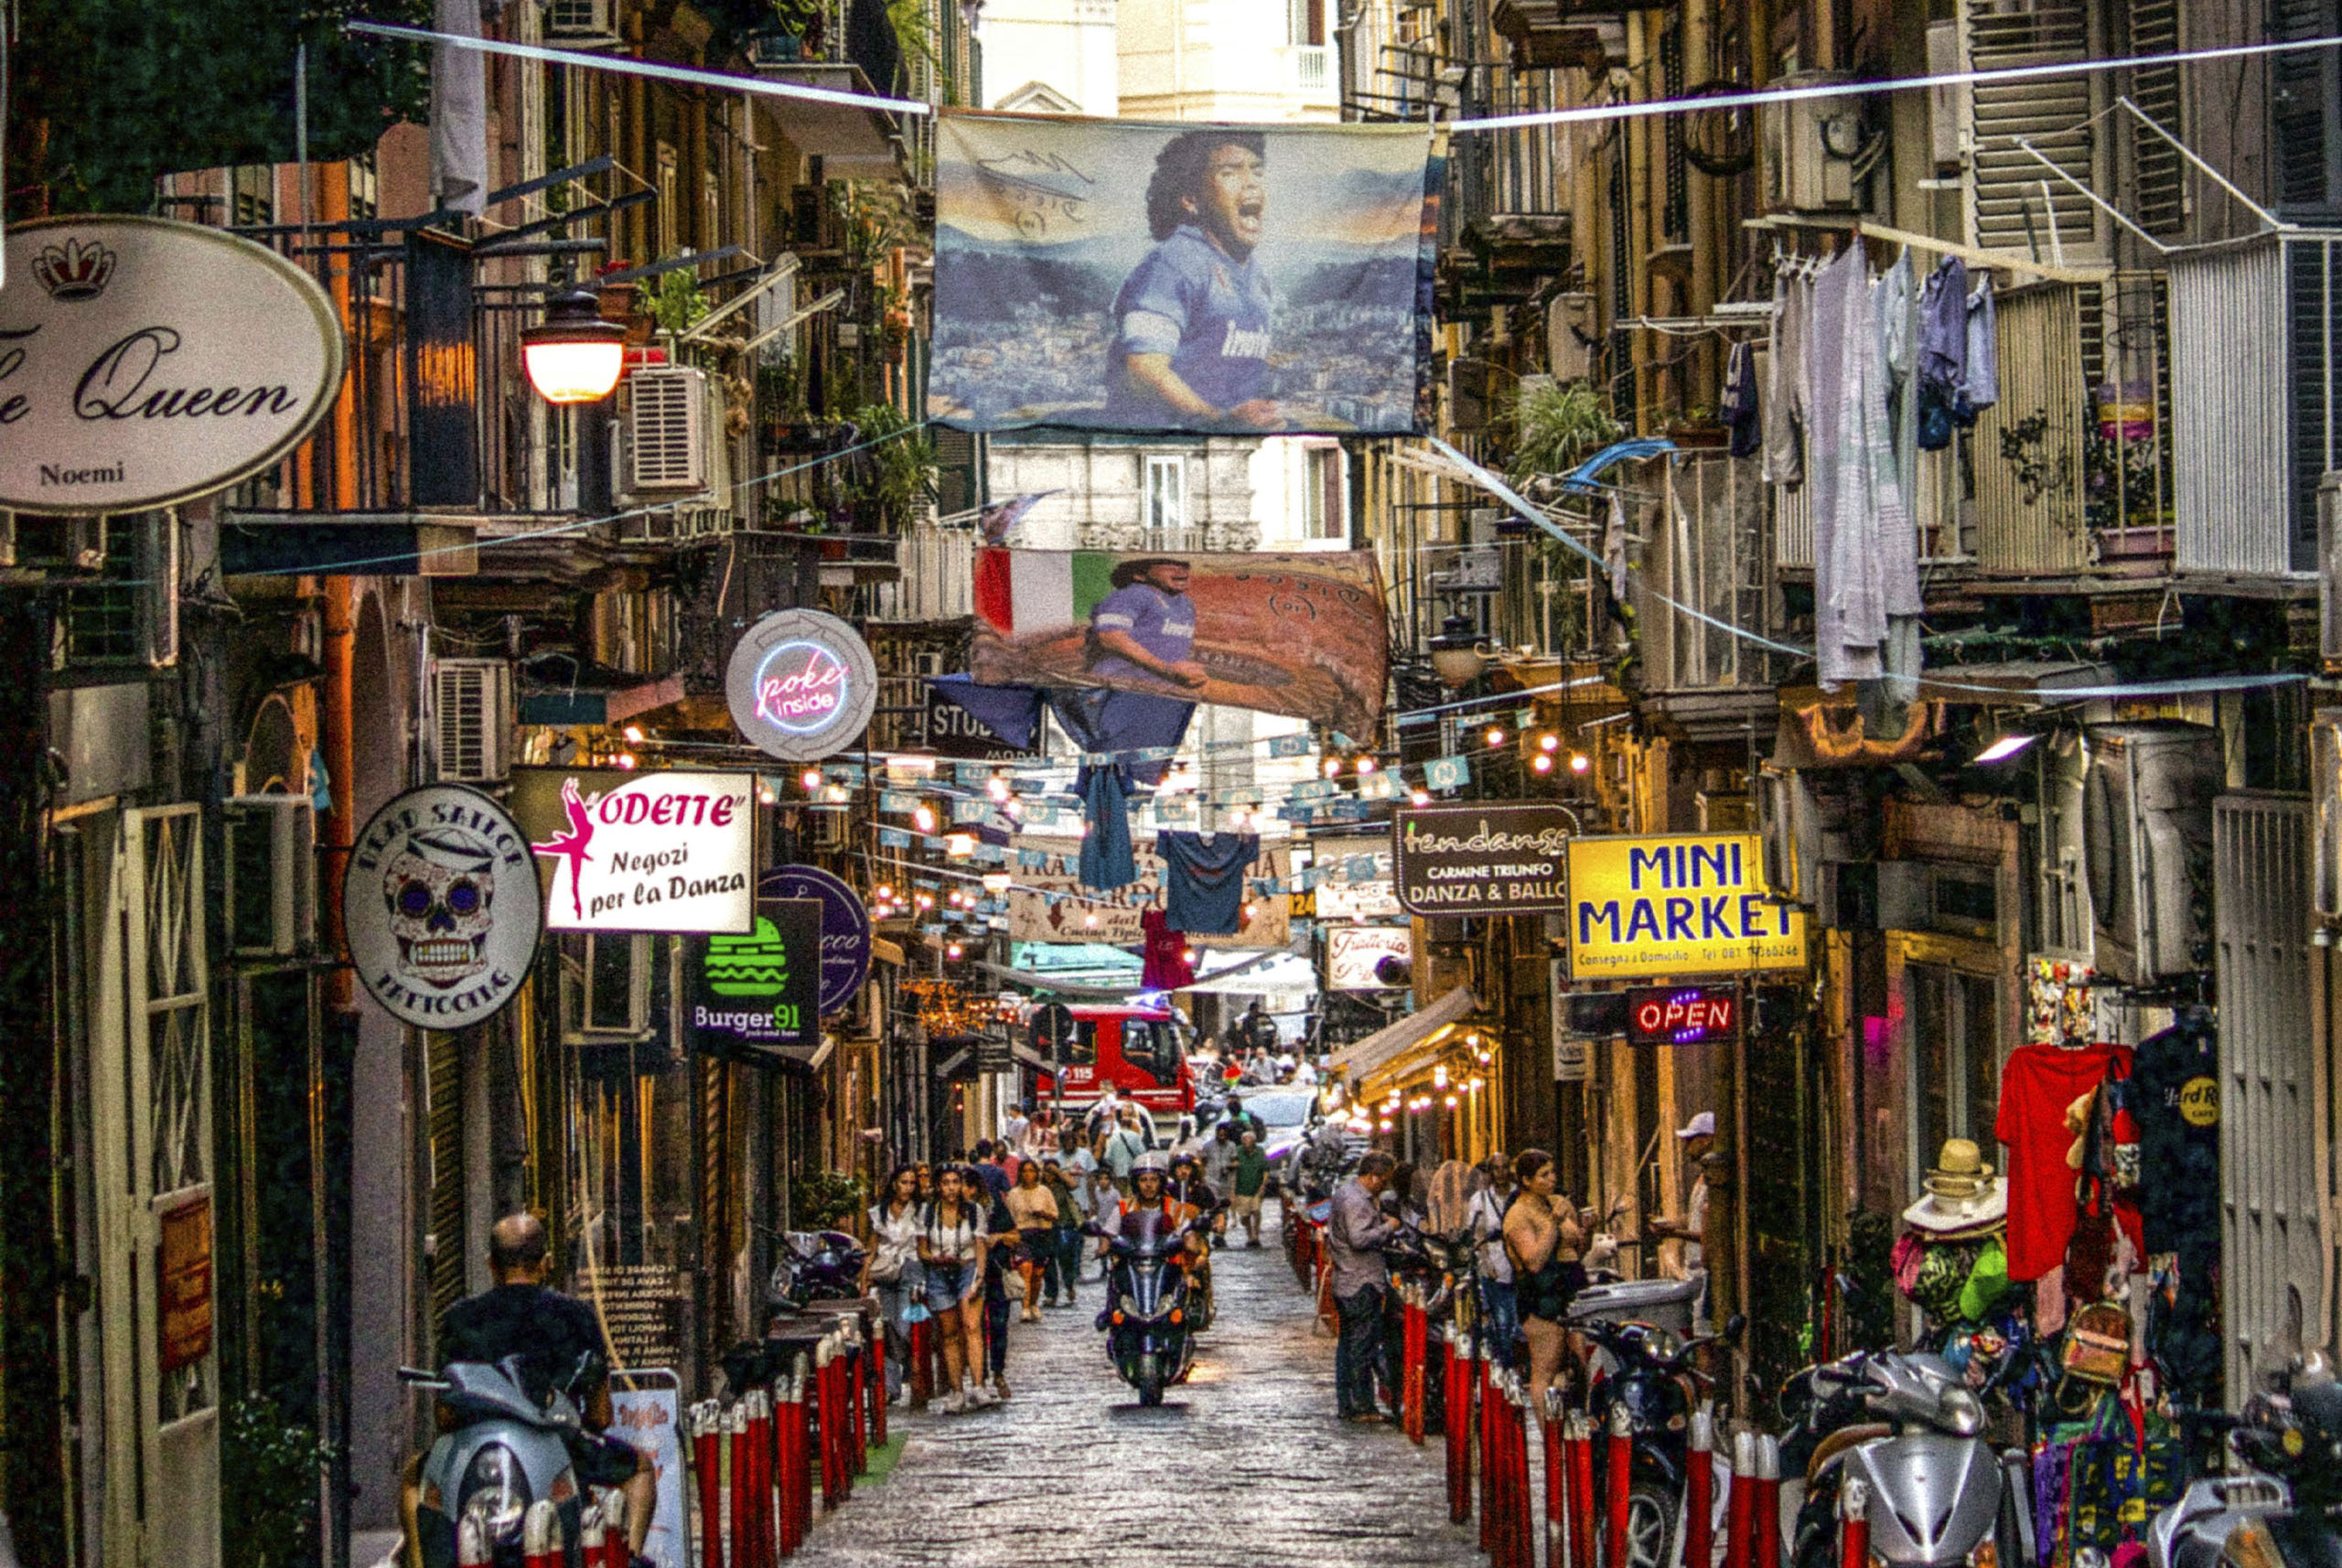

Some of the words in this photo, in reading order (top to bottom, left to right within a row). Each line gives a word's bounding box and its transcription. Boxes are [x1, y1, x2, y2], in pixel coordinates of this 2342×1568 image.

[73, 326, 300, 421] Queen
[40, 460, 124, 487] Noemi
[754, 650, 851, 719] poke
[777, 693, 835, 718] inside
[933, 703, 993, 737] STU
[357, 809, 419, 870] DEAD
[431, 802, 523, 870] SAILOR
[609, 843, 690, 876] Negozi
[1427, 865, 1490, 880] CARMINE
[1494, 863, 1554, 877] TRIUNFO
[1628, 843, 1743, 891] MINI
[590, 892, 626, 918] per
[634, 882, 661, 906] la
[669, 873, 746, 900] Danza
[1410, 883, 1483, 904] DANZA
[1487, 882, 1503, 901] &
[1578, 953, 1629, 968] Consegna
[1639, 1001, 1730, 1029] OPEN
[1073, 1067, 1093, 1080] 115
